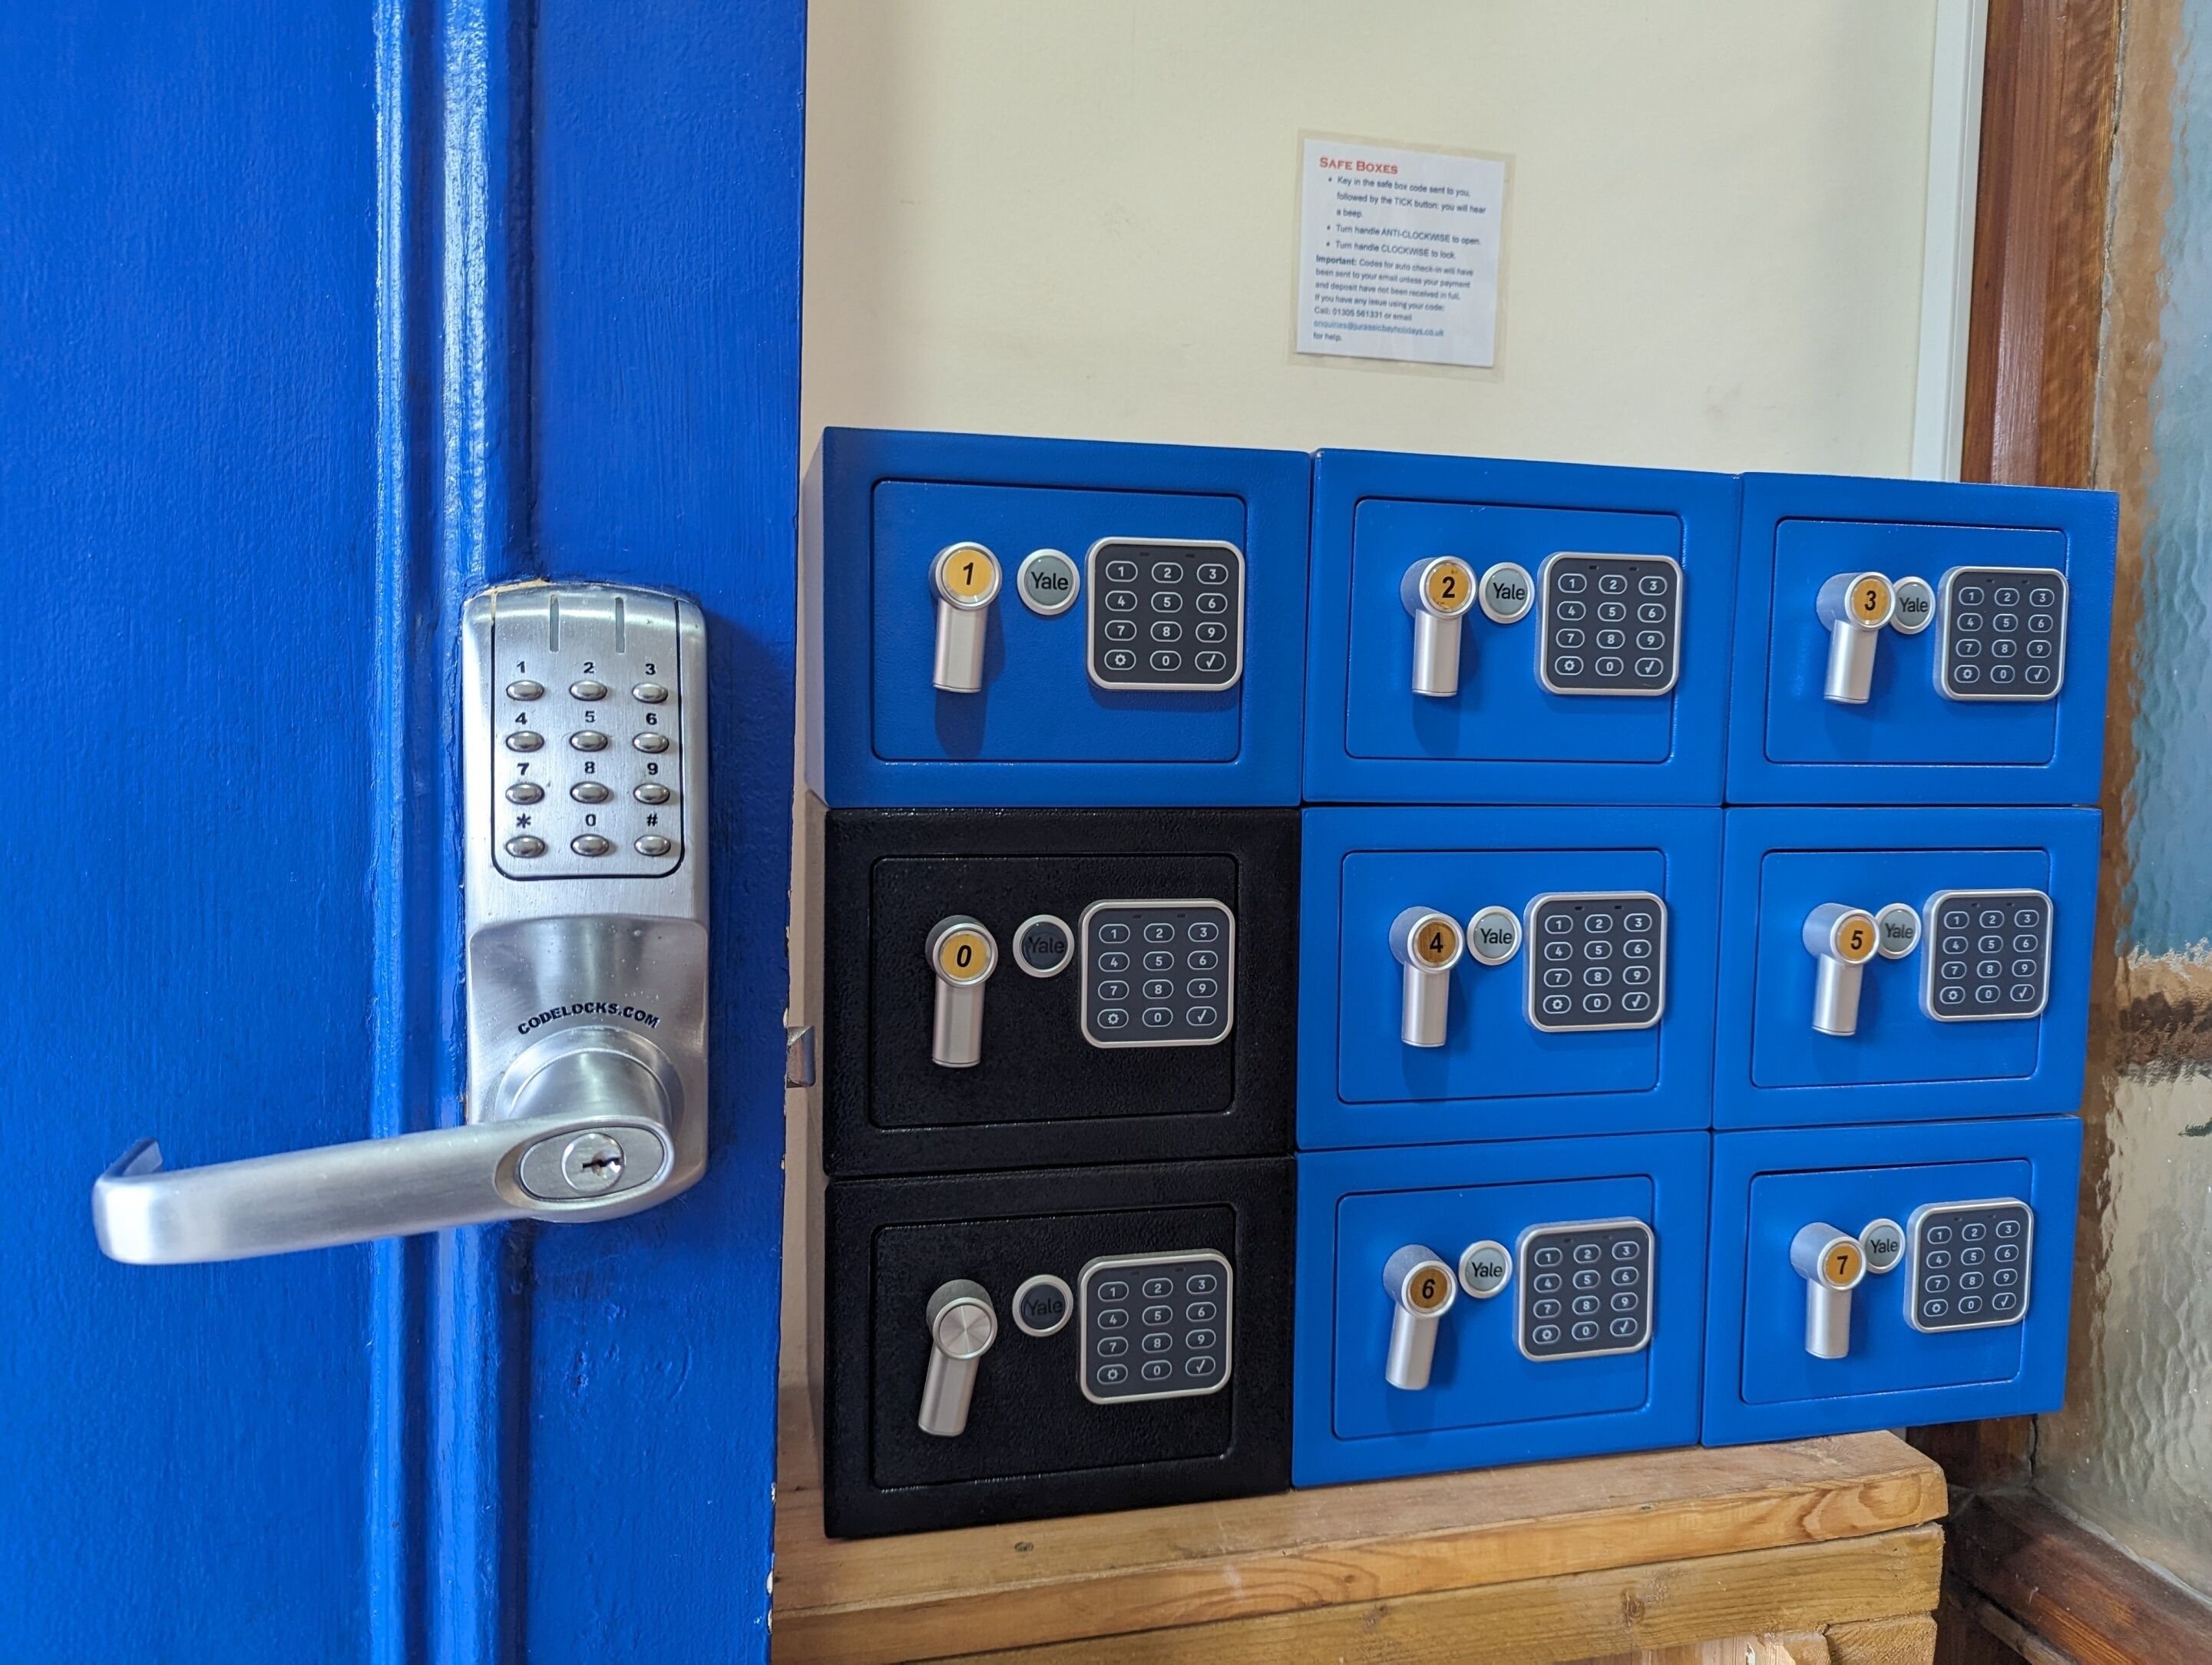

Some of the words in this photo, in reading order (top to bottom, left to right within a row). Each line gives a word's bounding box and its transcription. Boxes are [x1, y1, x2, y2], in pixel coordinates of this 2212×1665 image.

[1319, 157, 1353, 170] SAFE
[1356, 160, 1398, 175] BOXES
[1337, 176, 1352, 187] Key
[1362, 178, 1375, 187] the
[1376, 180, 1392, 189] safe
[1394, 182, 1407, 190] box
[1409, 184, 1427, 192] code
[1429, 186, 1445, 194] sent
[1337, 192, 1367, 203] followed
[1369, 195, 1379, 205] by
[1394, 197, 1413, 206] TICK
[1470, 205, 1486, 213] hear
[1336, 225, 1353, 233] Turn
[1354, 226, 1380, 236] handle
[1381, 228, 1450, 243] ANTI-CLOCKWISE
[1336, 240, 1352, 249] Turn
[1354, 242, 1379, 252] handle
[1381, 244, 1430, 257] CLOCKWISE
[1431, 249, 1438, 258] to
[1316, 254, 1357, 266] Important:
[1359, 259, 1382, 268] Codes
[1395, 263, 1410, 271] auto
[1412, 264, 1442, 273] check-in
[1315, 268, 1334, 276] been
[1378, 274, 1397, 282] email
[1399, 276, 1422, 284] unless
[1439, 280, 1470, 288] payment
[1330, 282, 1357, 291] deposit
[1409, 290, 1438, 298] received
[1314, 307, 1331, 315] Call:
[1368, 298, 1387, 307] issue
[1389, 301, 1407, 310] using
[962, 562, 975, 586] 1
[1118, 566, 1124, 577] 1
[1164, 568, 1171, 578] 2
[1209, 569, 1216, 579] 3
[1030, 571, 1069, 591] Yale
[1442, 576, 1456, 599] 2
[1493, 582, 1525, 601] Yale
[1968, 592, 1974, 601] 1
[2004, 592, 2011, 602] 2
[2039, 593, 2046, 603] 3
[1118, 596, 1125, 606] 4
[1164, 597, 1171, 607] 5
[1208, 598, 1216, 609] 6
[1864, 590, 1877, 611] 3
[1899, 597, 1929, 613] Yale
[1967, 617, 1974, 627] 4
[2003, 618, 2010, 628] 5
[2038, 619, 2045, 628] 6
[1117, 625, 1125, 636] 7
[1163, 626, 1170, 637] 8
[1208, 627, 1215, 638] 9
[1966, 643, 1973, 653] 7
[2001, 644, 2008, 653] 8
[2036, 644, 2043, 654] 9
[516, 661, 526, 674] 1
[584, 662, 595, 674] 2
[645, 663, 656, 676] 3
[1162, 656, 1170, 666] 0
[2000, 669, 2007, 679] 0
[515, 712, 528, 725] 4
[585, 710, 595, 723] 5
[646, 713, 658, 725] 6
[517, 762, 530, 775] 7
[584, 761, 595, 775] 8
[647, 762, 659, 775] 9
[585, 814, 597, 827] 0
[647, 814, 658, 826] #
[1556, 920, 1562, 930] 1
[1595, 918, 1603, 929] 2
[1634, 918, 1642, 928] 3
[1885, 923, 1914, 939] Yale
[1111, 929, 1117, 939] 1
[1156, 928, 1163, 938] 2
[1200, 927, 1207, 937] 3
[1480, 928, 1512, 945] Yale
[1850, 930, 1863, 950] 5
[1028, 937, 1065, 955] Yale
[1429, 932, 1443, 953] 4
[1555, 946, 1563, 956] 4
[1595, 945, 1603, 955] 5
[1634, 944, 1642, 954] 6
[956, 945, 972, 968] 0
[1110, 957, 1118, 967] 4
[1155, 956, 1163, 966] 5
[1199, 955, 1207, 965] 6
[1554, 973, 1562, 983] 7
[1594, 971, 1602, 982] 8
[1633, 970, 1641, 980] 9
[1110, 985, 1118, 996] 7
[1154, 984, 1162, 995] 8
[1199, 983, 1206, 993] 9
[1593, 998, 1601, 1008] 0
[517, 1002, 660, 1035] CODELOCKS.COM
[1154, 1012, 1162, 1022] 0
[1937, 1231, 1942, 1240] 1
[1971, 1228, 1978, 1237] 2
[2005, 1225, 2012, 1234] 3
[1870, 1239, 1898, 1254] Yale
[1936, 1255, 1942, 1264] 4
[1970, 1252, 1977, 1261] 5
[2004, 1249, 2011, 1258] 6
[1471, 1262, 1503, 1278] Yale
[1837, 1255, 1848, 1275] 7
[1422, 1278, 1436, 1299] 6
[1935, 1279, 1941, 1289] 7
[1969, 1276, 1976, 1286] 8
[2003, 1273, 2009, 1282] 9
[1026, 1299, 1063, 1318] Yale
[1968, 1300, 1975, 1310] 0
